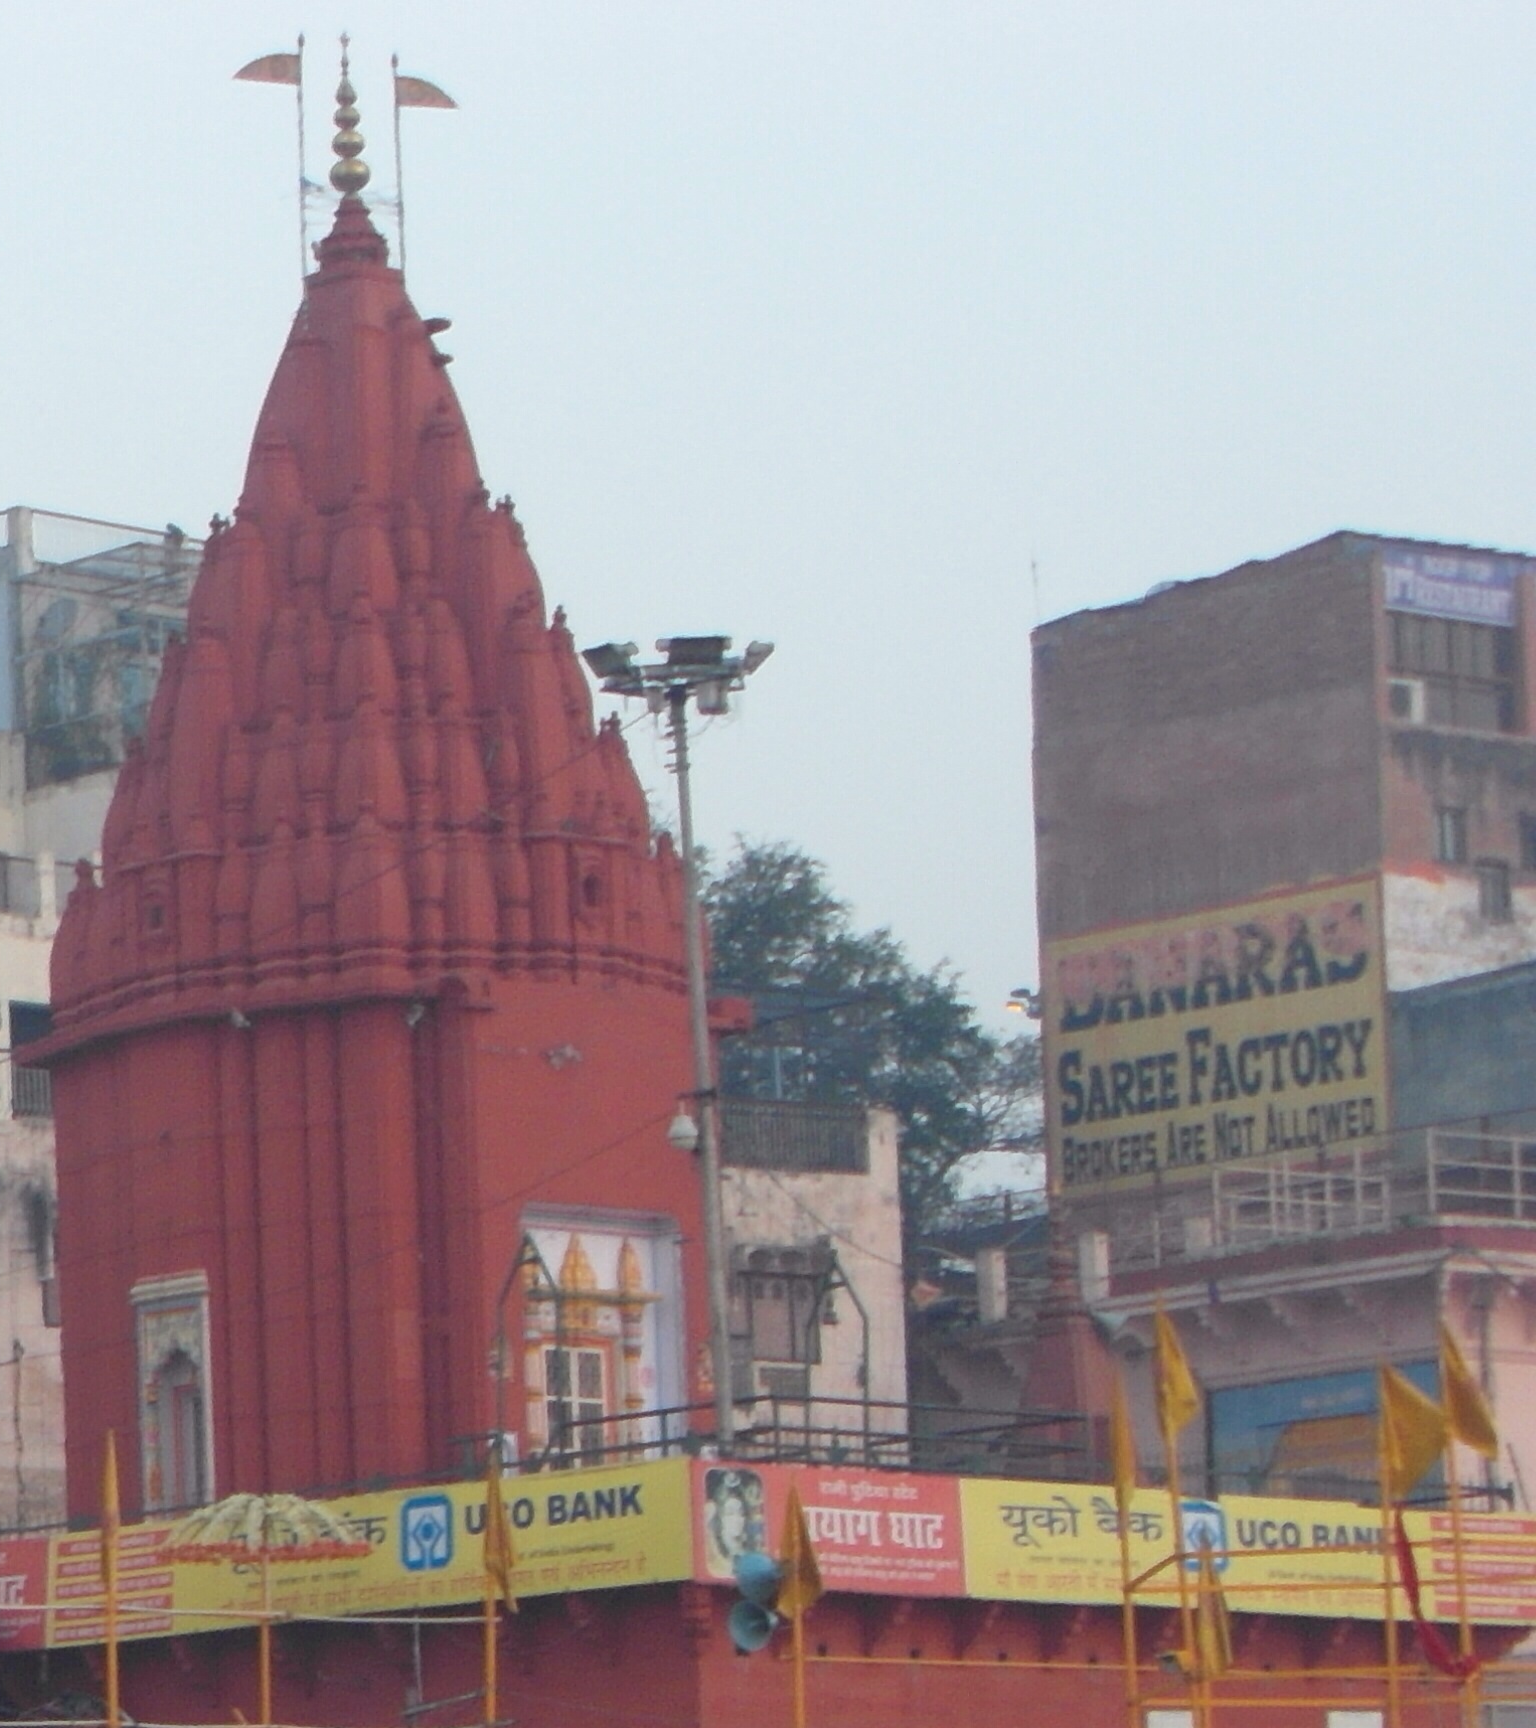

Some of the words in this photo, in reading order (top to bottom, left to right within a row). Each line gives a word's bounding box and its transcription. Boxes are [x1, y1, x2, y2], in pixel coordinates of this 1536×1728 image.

[1058, 1049, 1178, 1128] SAREE
[1185, 1018, 1372, 1106] FACTORY
[1063, 1131, 1158, 1183] BROKERS
[1167, 1121, 1206, 1166] ARE
[1214, 1112, 1256, 1161] NOT
[1266, 1097, 1376, 1158] ALLOWED
[465, 1497, 535, 1535] UO
[547, 1485, 643, 1527] BANK
[888, 1512, 944, 1549] घाट
[999, 1496, 1081, 1548] यूको
[1237, 1520, 1301, 1549] UCO
